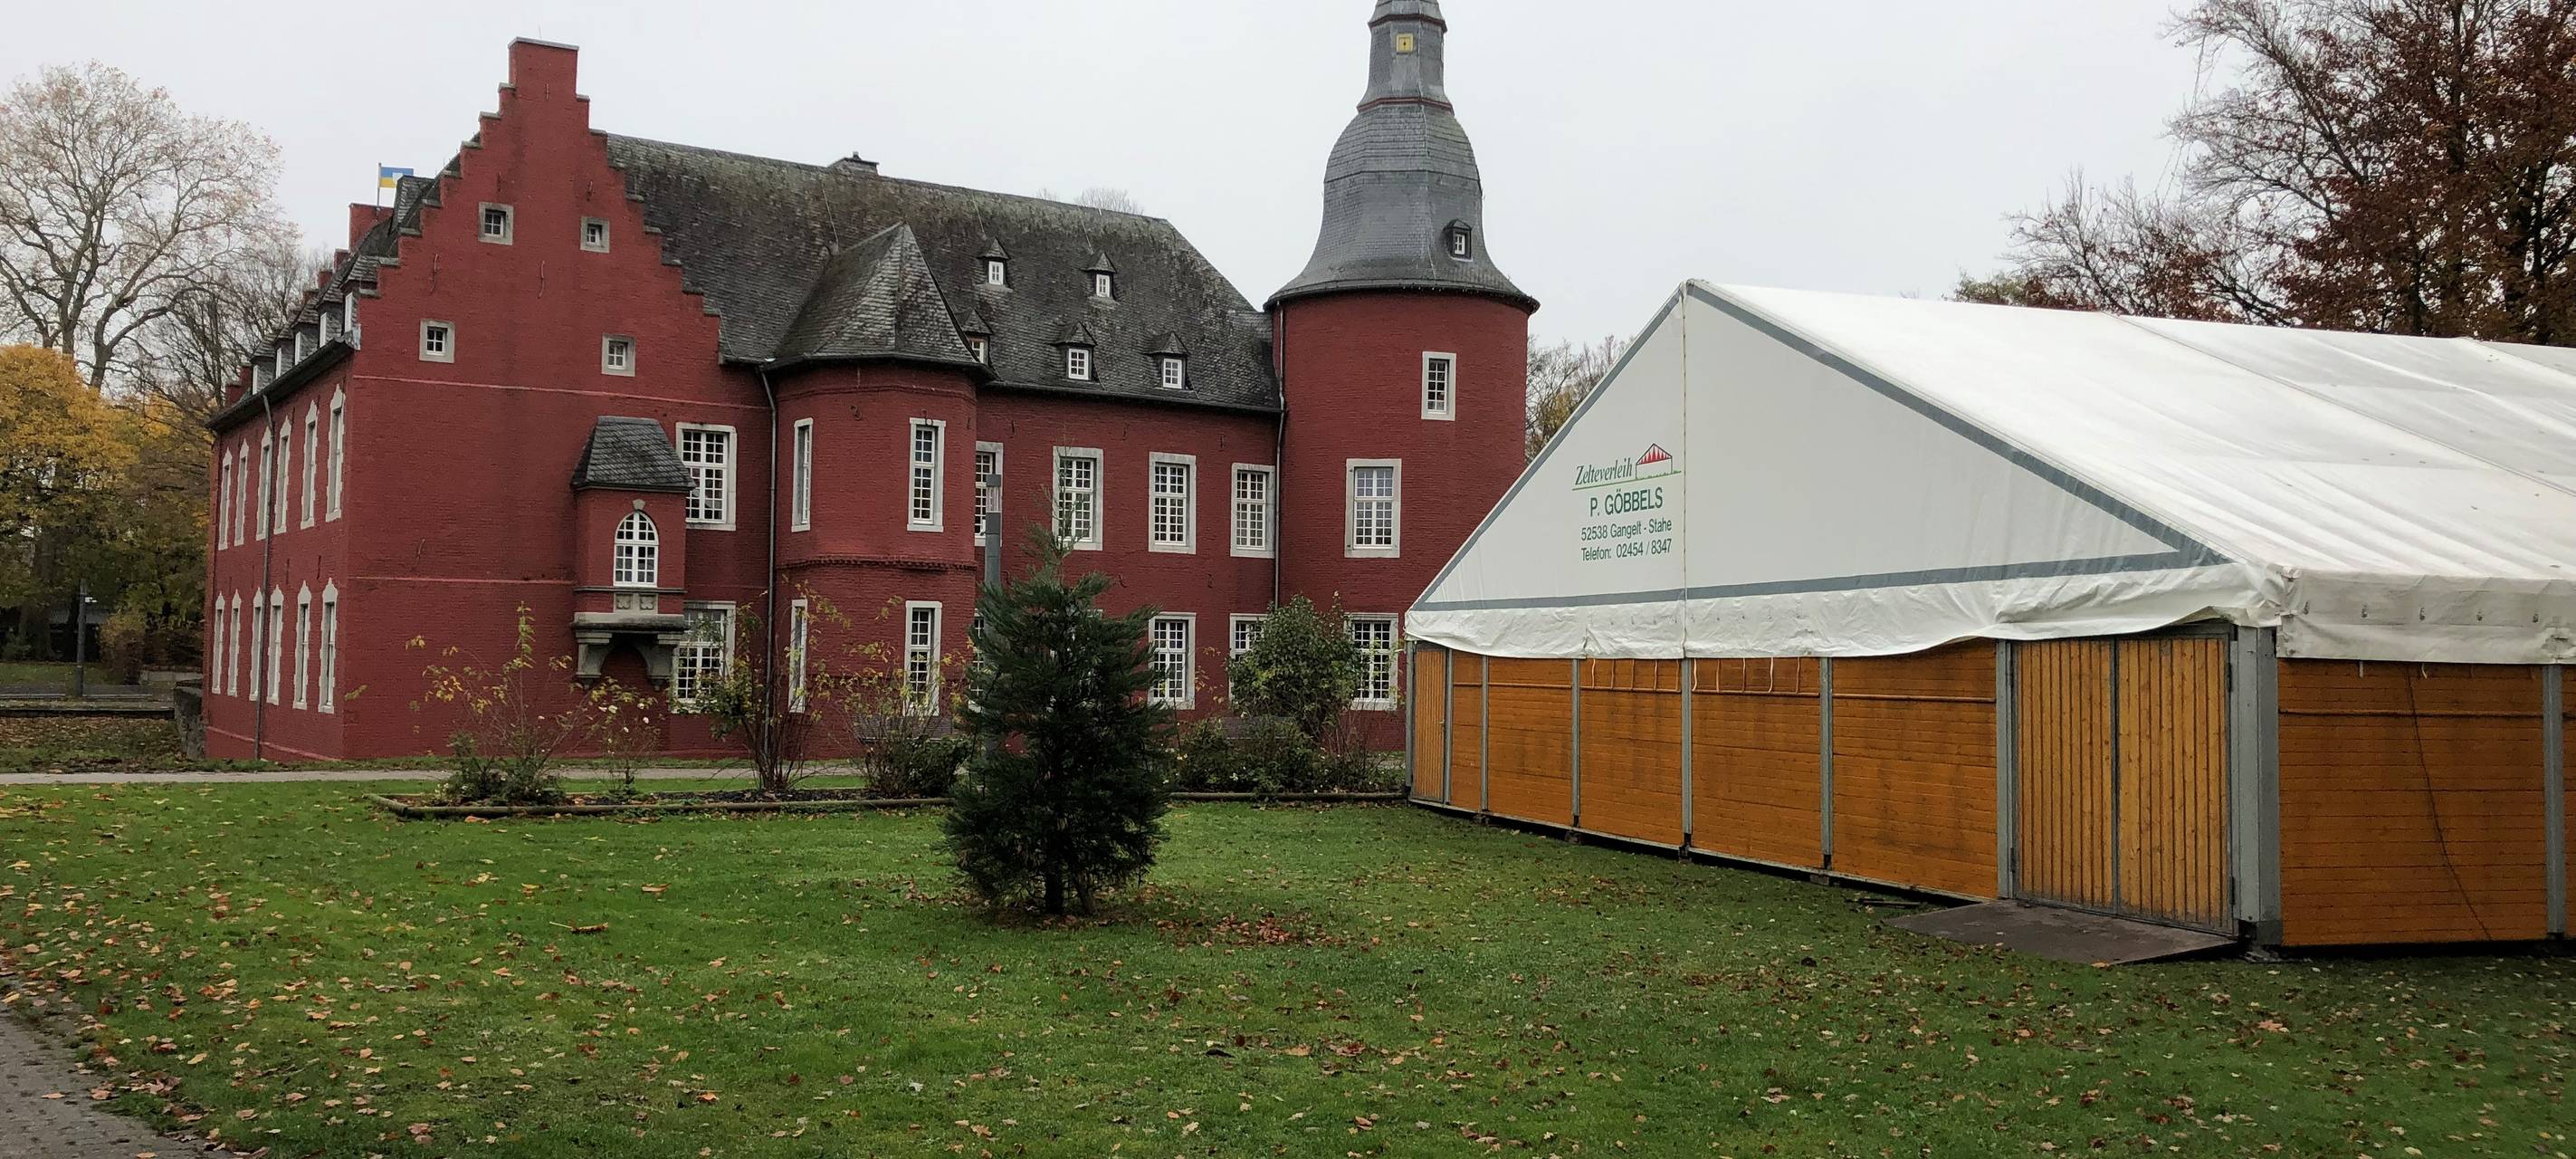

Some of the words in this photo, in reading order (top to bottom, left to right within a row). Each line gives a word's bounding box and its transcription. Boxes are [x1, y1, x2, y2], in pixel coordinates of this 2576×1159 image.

[1575, 457, 1633, 485] Zelteverleih
[1590, 497, 1600, 517] P.
[1605, 487, 1664, 515] GÖBBELS
[1581, 524, 1608, 541] 52538
[1610, 521, 1641, 539] Gangelt
[1648, 517, 1672, 533] Stahe
[1581, 546, 1611, 561] Telefon:
[1617, 541, 1644, 558] 02454
[1651, 539, 1672, 555] 8347
